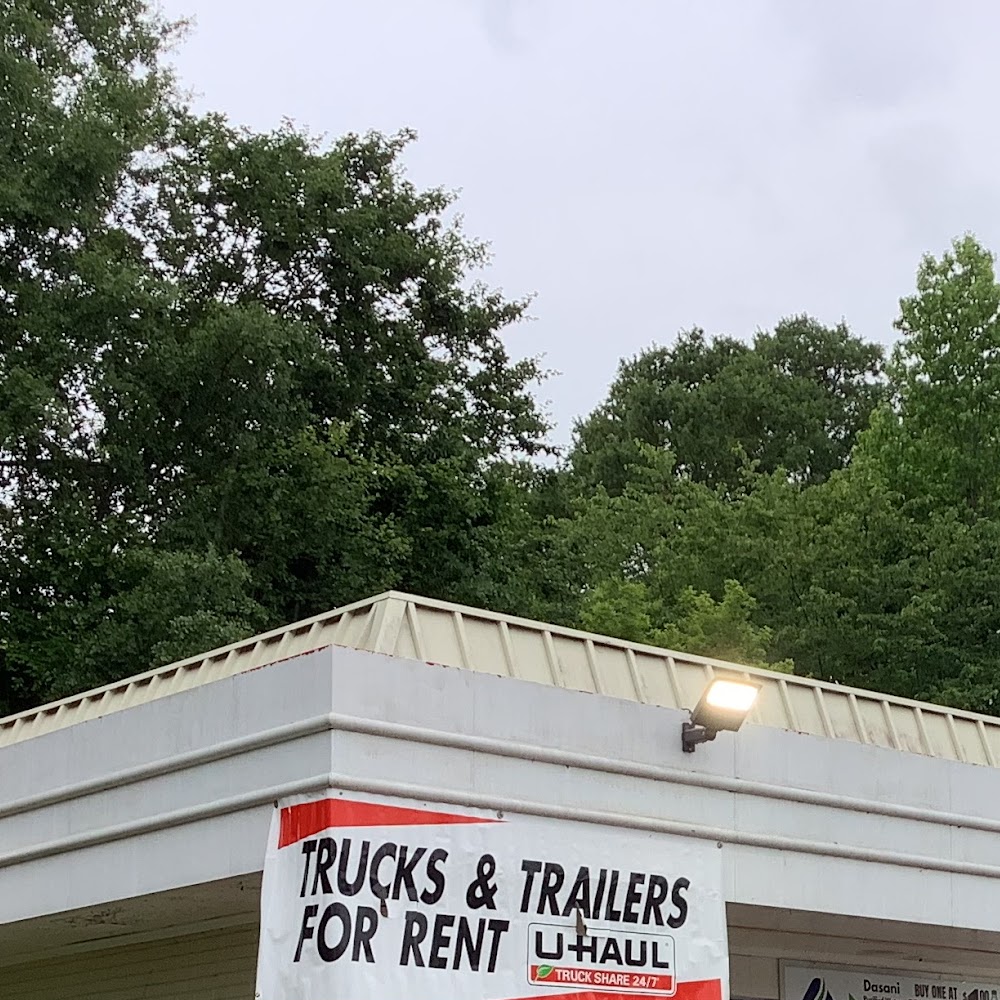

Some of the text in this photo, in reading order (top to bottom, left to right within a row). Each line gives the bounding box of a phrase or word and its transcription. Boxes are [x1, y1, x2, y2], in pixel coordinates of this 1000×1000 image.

[300, 837, 691, 929] TRUCKS & TRAILERS
[294, 902, 510, 974] FOR RENT
[535, 931, 669, 969] U-HAUL
[555, 968, 659, 988] TRUCK SHARE 24/7
[863, 979, 900, 995] Dasani
[914, 984, 958, 1000] BUY ONE AT
